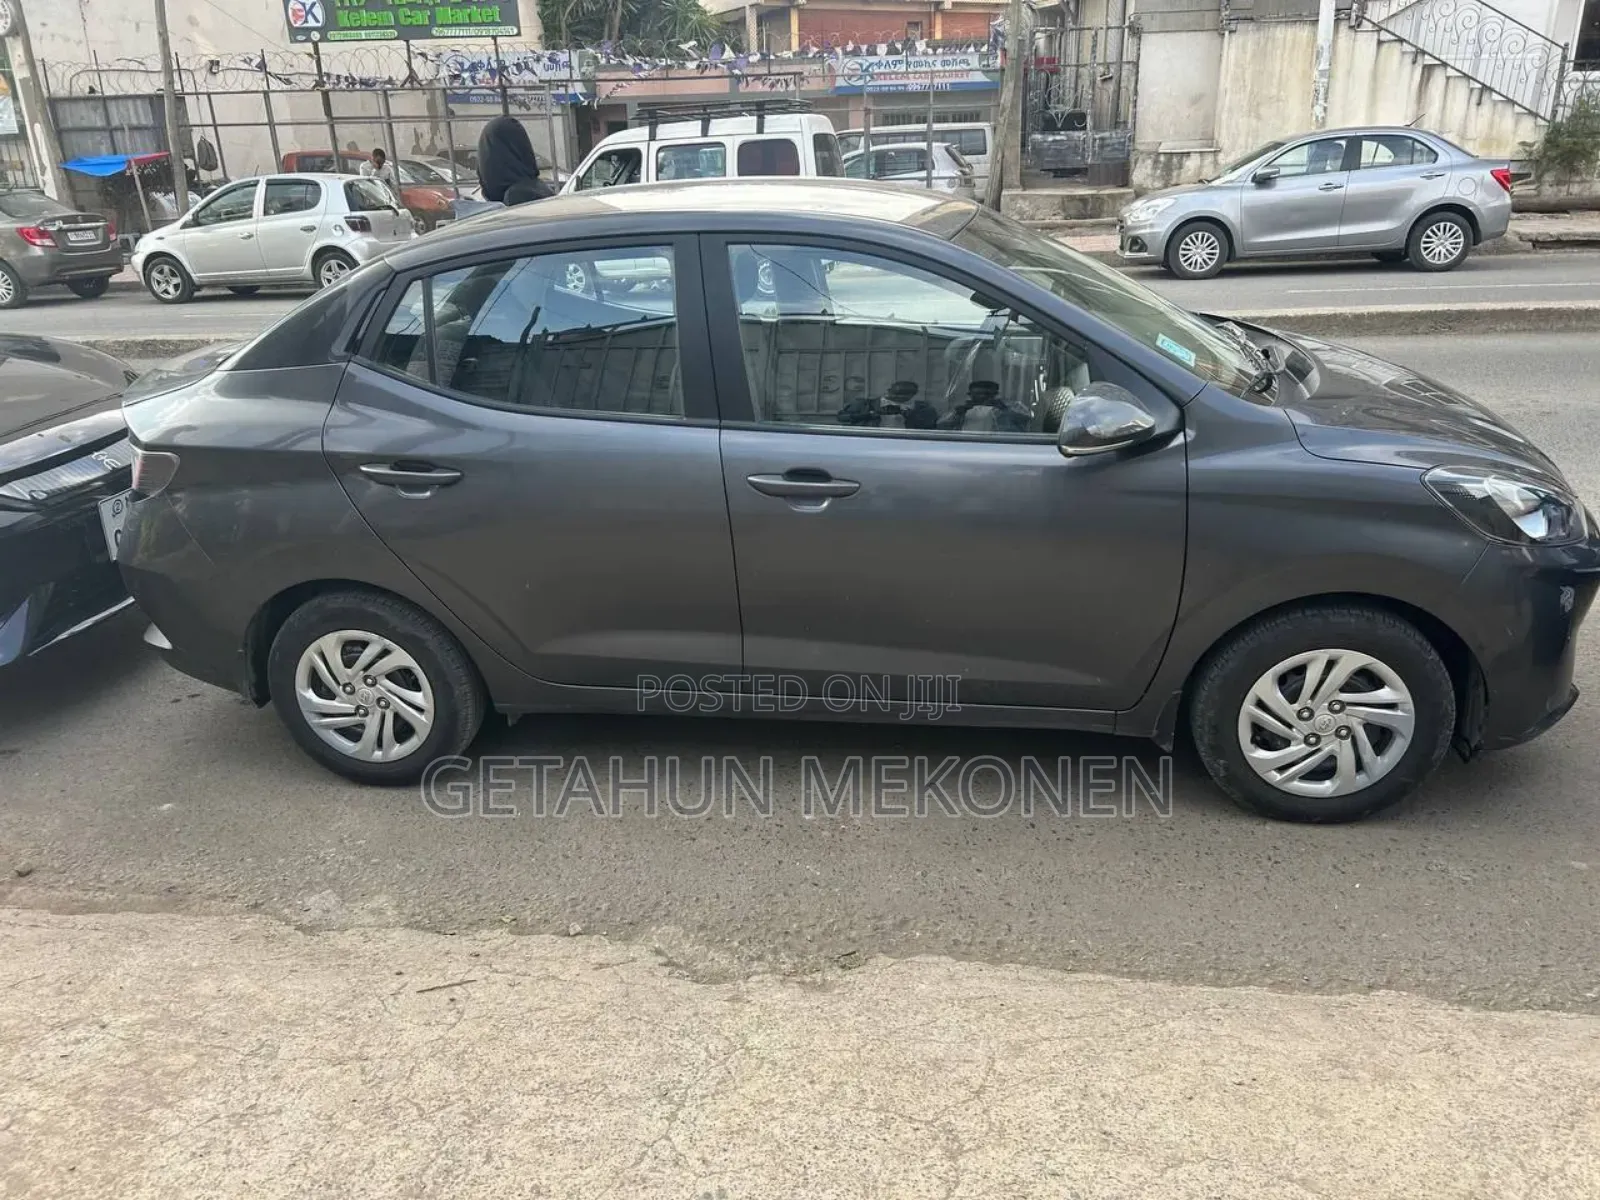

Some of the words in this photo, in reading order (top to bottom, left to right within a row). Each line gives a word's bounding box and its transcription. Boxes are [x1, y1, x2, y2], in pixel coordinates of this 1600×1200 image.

[337, 9, 395, 27] Kelem
[398, 8, 430, 25] Car
[435, 6, 501, 24] Market
